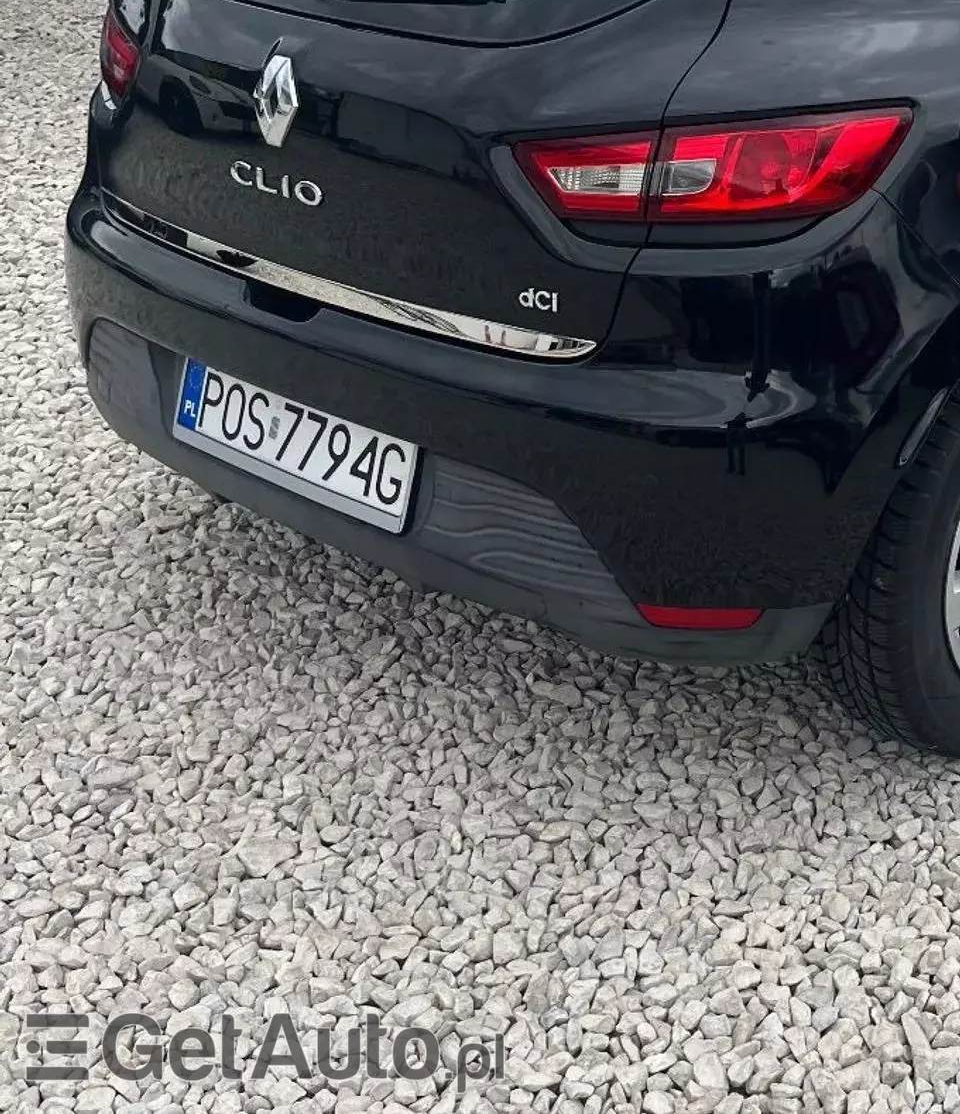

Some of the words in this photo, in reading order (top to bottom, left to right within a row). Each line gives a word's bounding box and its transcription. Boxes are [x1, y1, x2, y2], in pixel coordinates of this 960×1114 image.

[229, 160, 324, 206] CLIO
[184, 398, 196, 418] PL
[197, 371, 270, 451] POS
[275, 401, 407, 505] 7794G
